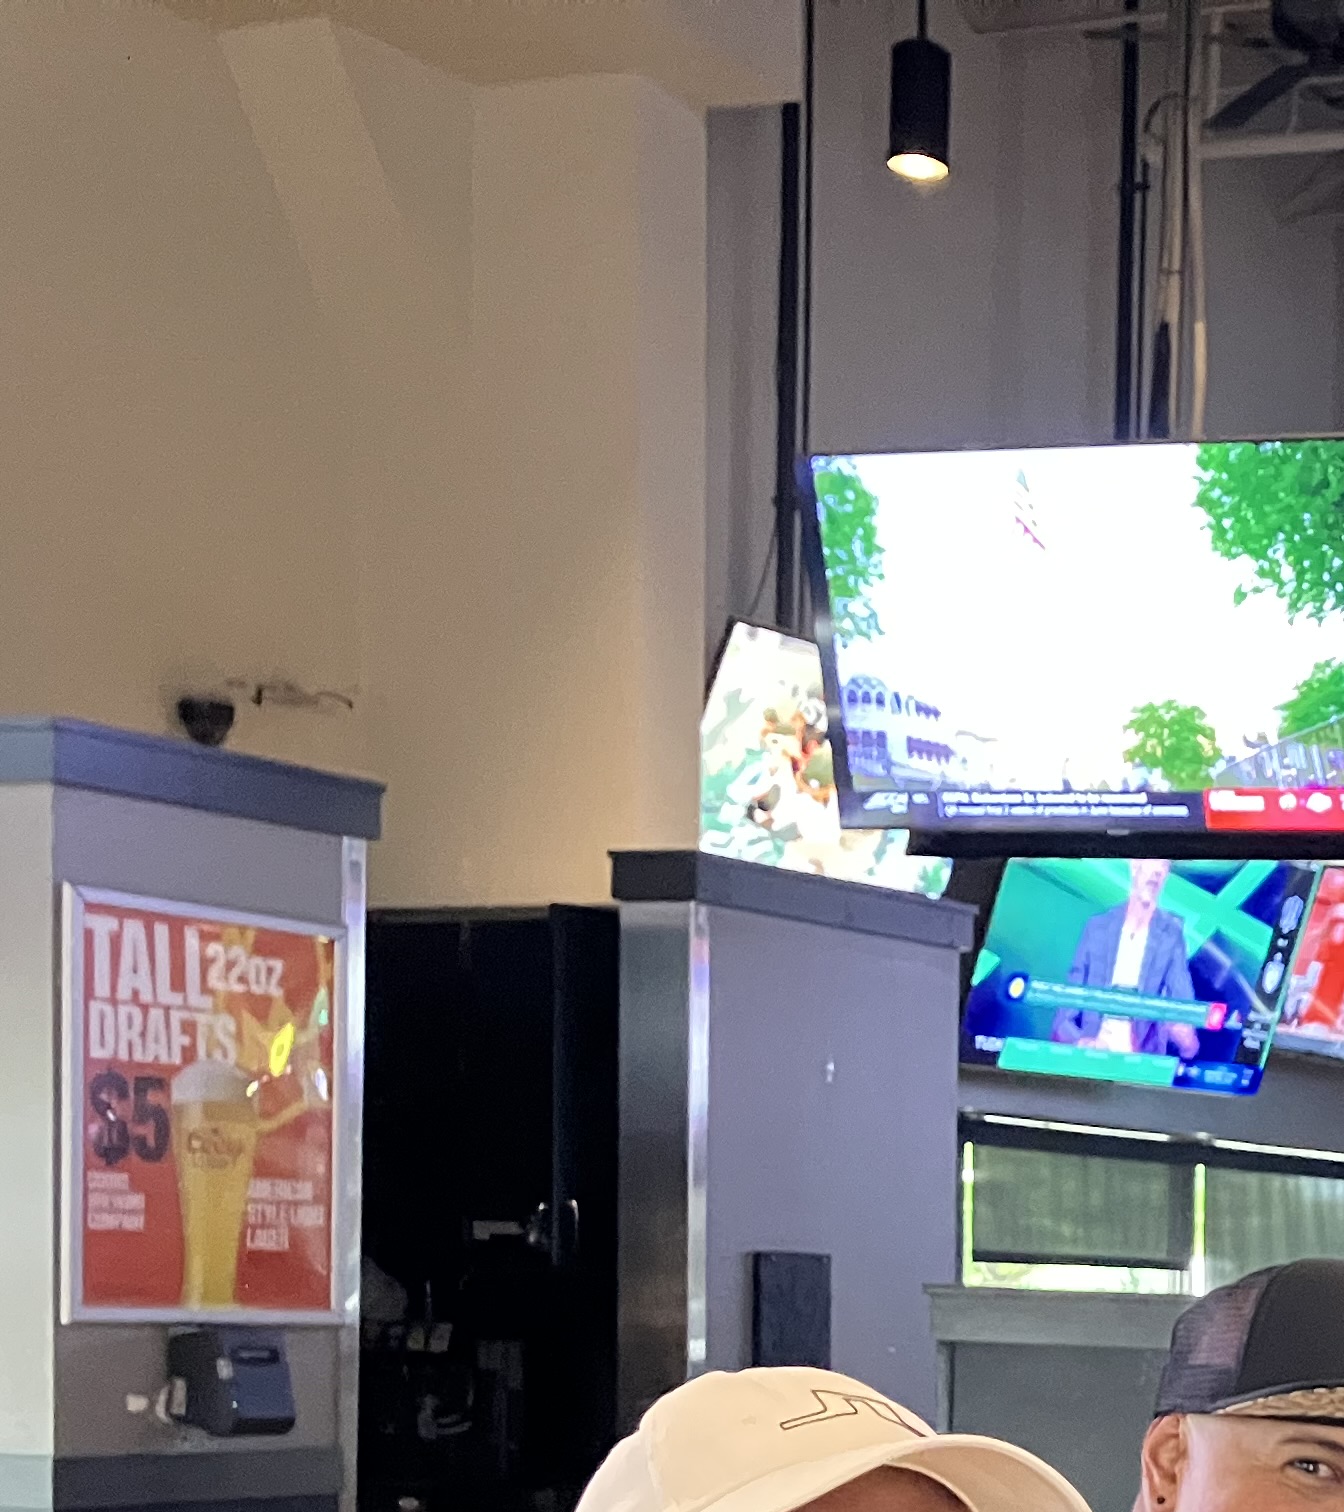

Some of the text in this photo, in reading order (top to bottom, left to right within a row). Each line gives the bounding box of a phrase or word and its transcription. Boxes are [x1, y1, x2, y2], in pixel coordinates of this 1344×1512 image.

[84, 912, 214, 1009] TALL
[89, 999, 237, 1066] DRAFTS
[90, 1067, 172, 1166] $5
